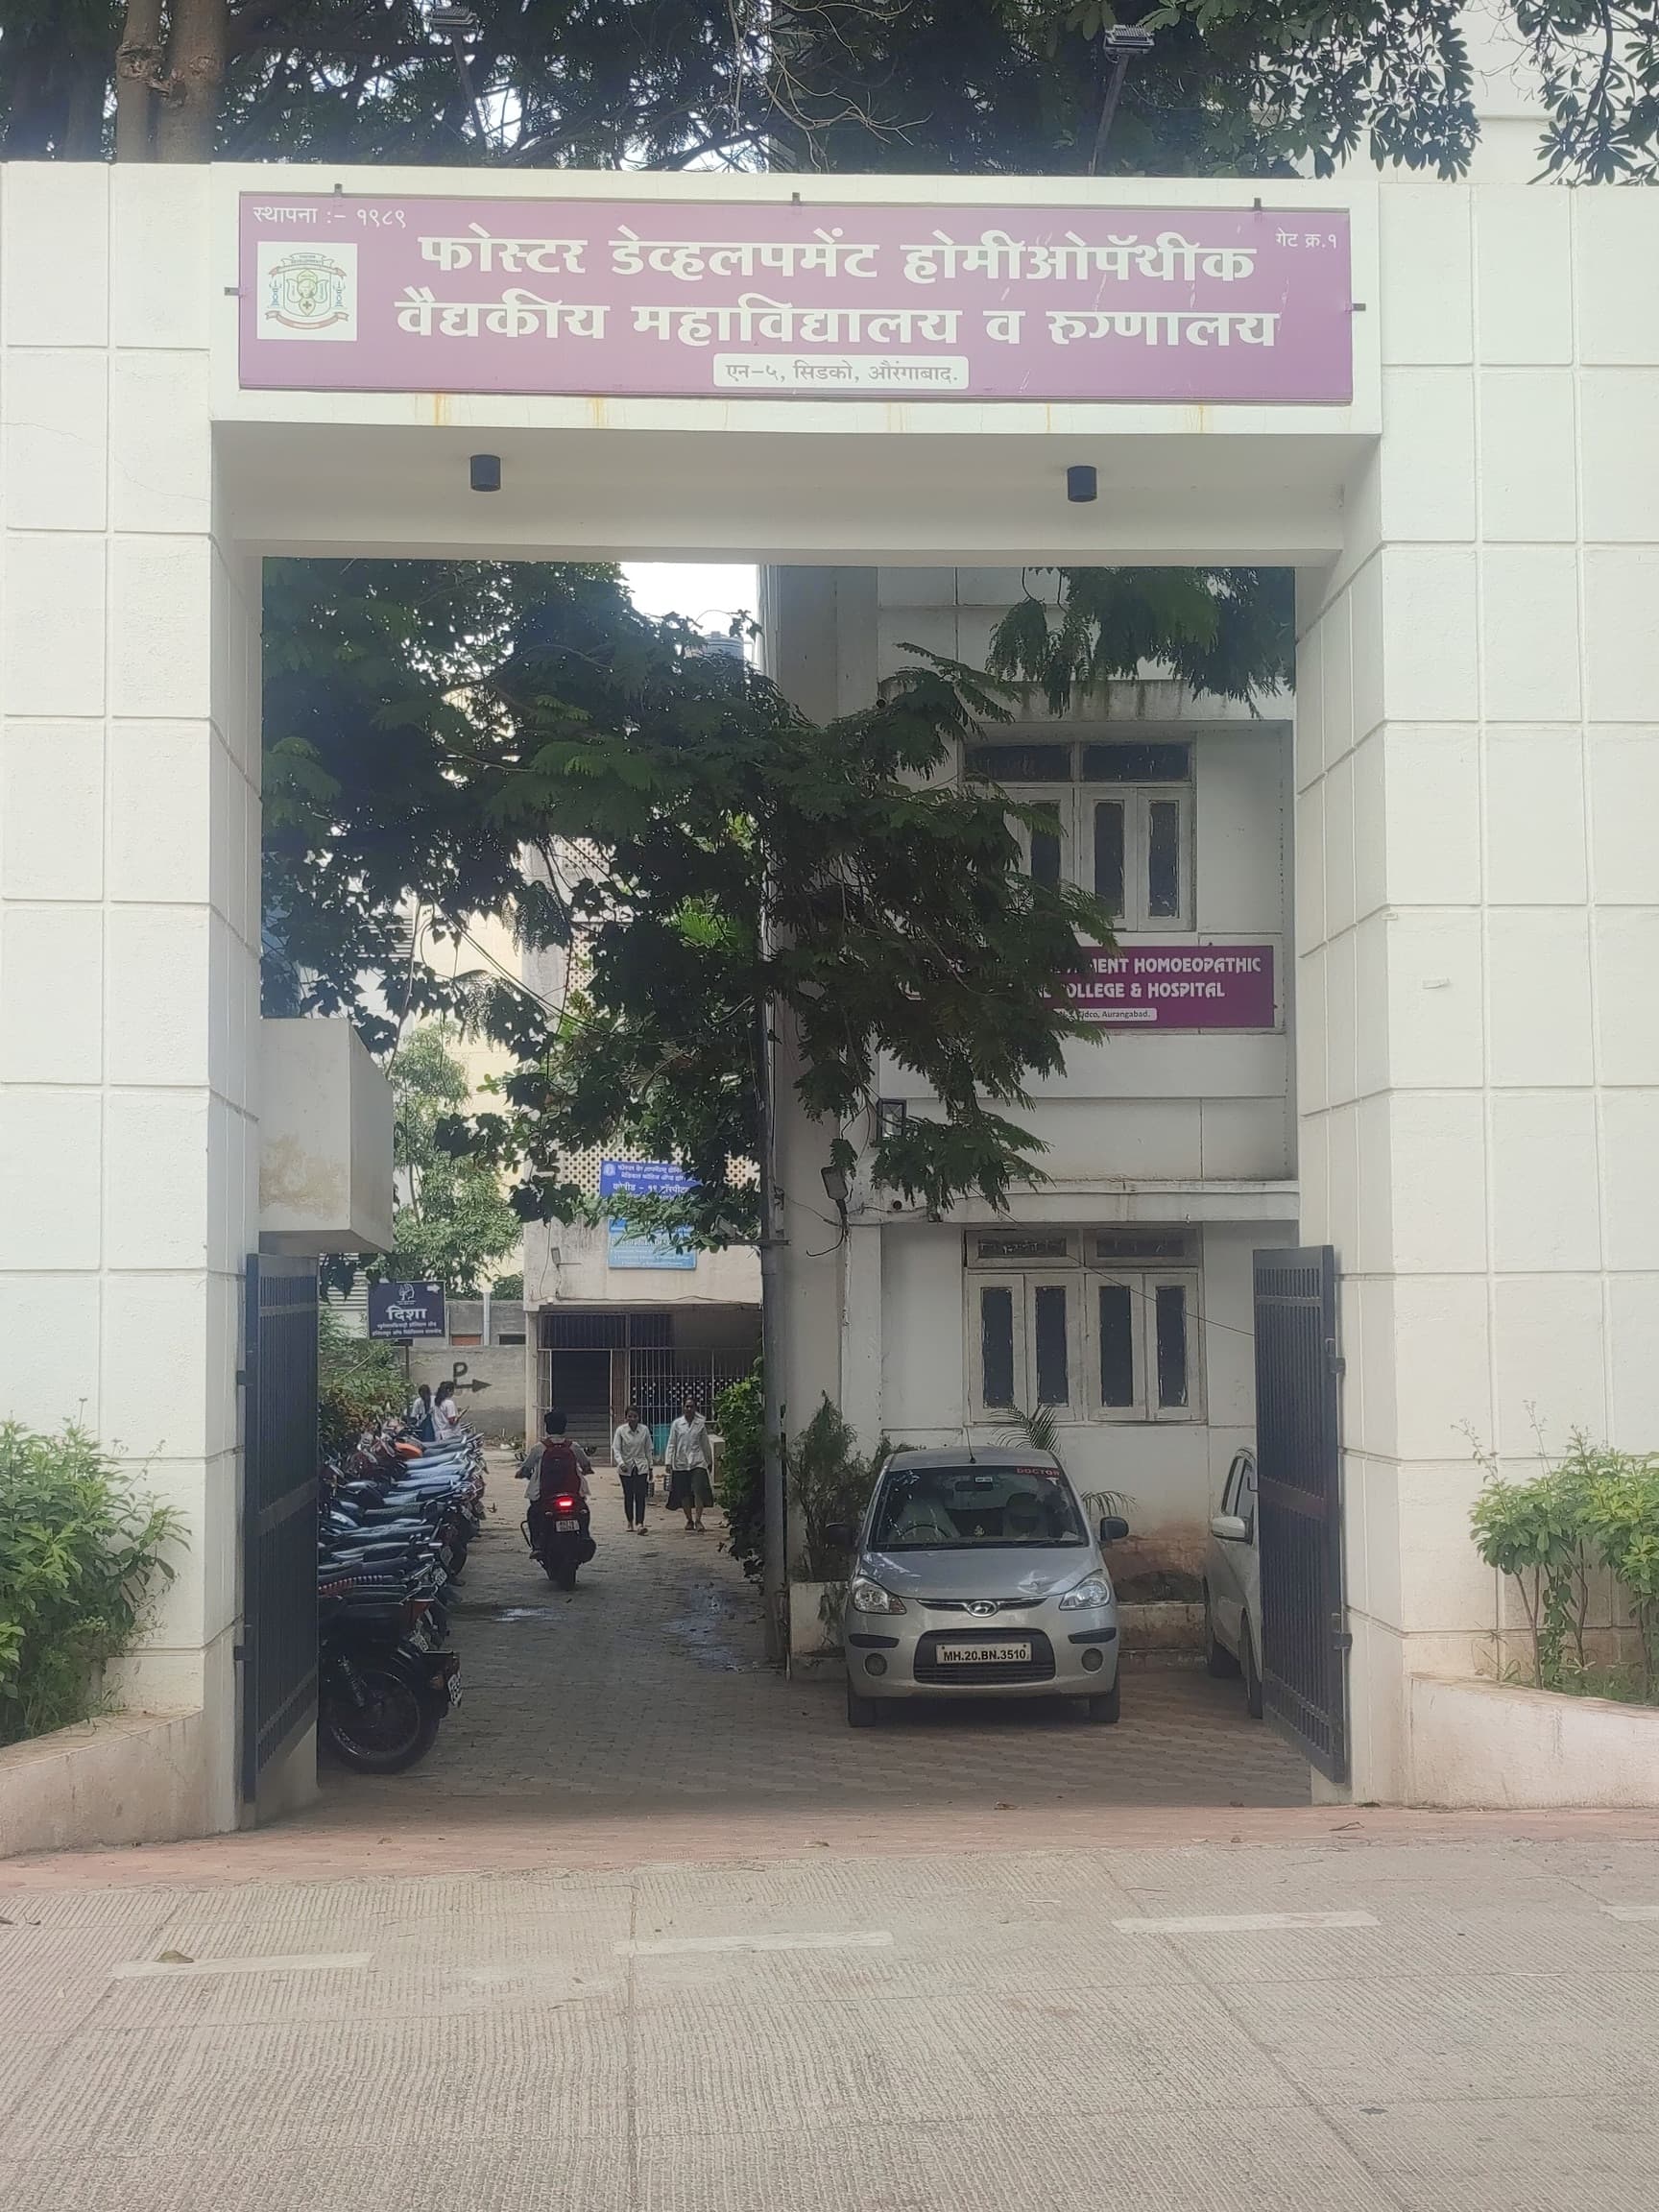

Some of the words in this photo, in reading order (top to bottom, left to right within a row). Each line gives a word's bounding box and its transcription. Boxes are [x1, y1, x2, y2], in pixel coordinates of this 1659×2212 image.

[252, 206, 318, 224] स्थापना
[356, 208, 406, 228] १९८९
[1275, 227, 1299, 247] गेट
[418, 222, 589, 274] फोस्टर
[608, 224, 880, 281] डेव्हलपमेंट
[900, 229, 1258, 284] होमीओपॅथीक
[394, 285, 611, 340] वैद्यकीय
[630, 292, 964, 347] महाविद्यालय
[982, 310, 1025, 345] व
[1046, 310, 1280, 347] रुग्णालय
[793, 359, 860, 382] सिडको,
[868, 359, 959, 384] औरंगाबाद.
[1134, 958, 1262, 974] HOMOEOPATHIC
[1067, 982, 1125, 998] OLLEGE
[1130, 983, 1142, 998] &
[1147, 983, 1225, 999] HOSPITAL
[385, 1304, 427, 1321] दिशा
[944, 1648, 1026, 1662] MH.20.BN.3510
